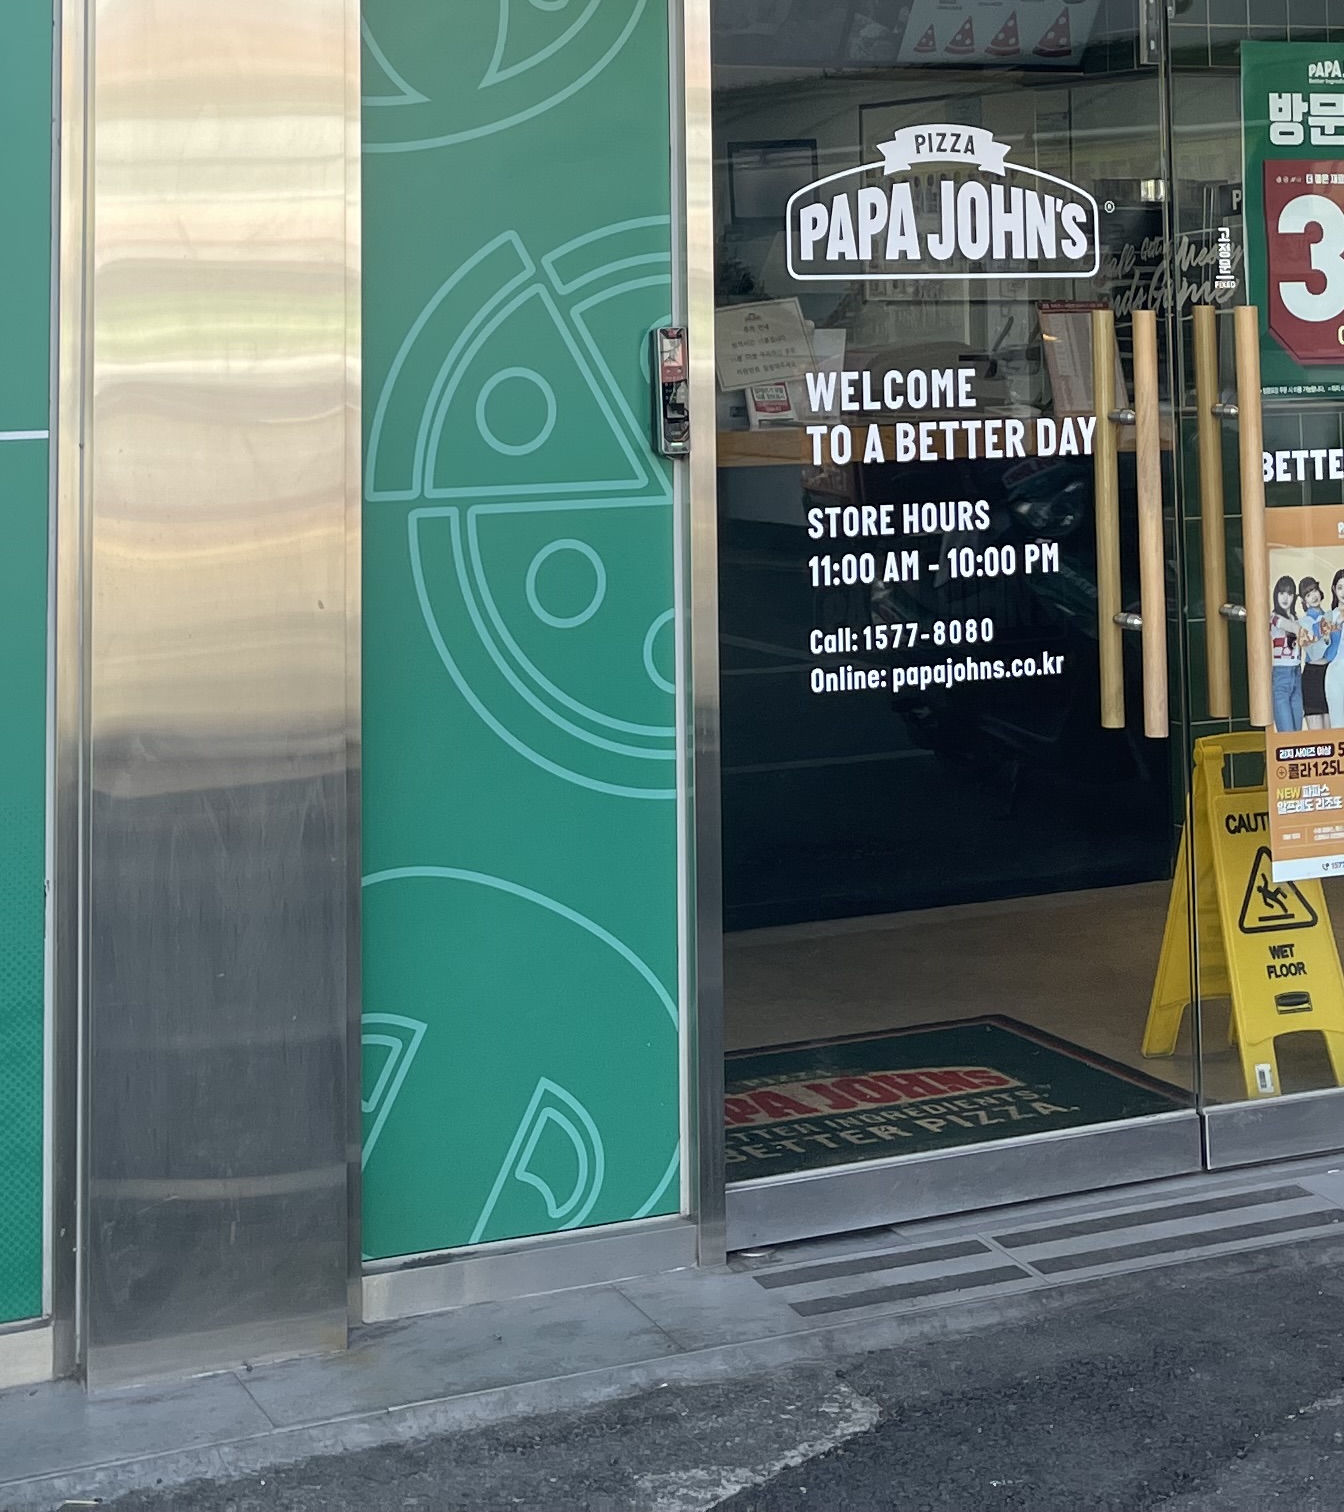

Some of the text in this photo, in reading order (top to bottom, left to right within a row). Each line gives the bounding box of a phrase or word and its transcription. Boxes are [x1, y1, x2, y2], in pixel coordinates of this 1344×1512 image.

[1308, 60, 1342, 79] PAPA
[914, 132, 977, 156] PIZZA
[799, 179, 1088, 262] PAPA JOHN'S
[806, 367, 978, 413] WELCOME
[806, 415, 1098, 467] TO A BETTER DAY
[807, 499, 991, 540] STORE HOURS
[808, 551, 876, 588] 11:00
[883, 549, 920, 583] AM
[946, 544, 1017, 580] 10:00
[1024, 542, 1060, 576] PM
[809, 617, 995, 655] Call: 1577-8080
[810, 650, 1065, 694] Online: papajohns.co.kr
[1312, 758, 1344, 777] 1.25L
[1276, 785, 1302, 800] NEW
[1225, 811, 1270, 835] CAUT
[1268, 943, 1295, 961] WET
[1266, 961, 1307, 980] FLOOR
